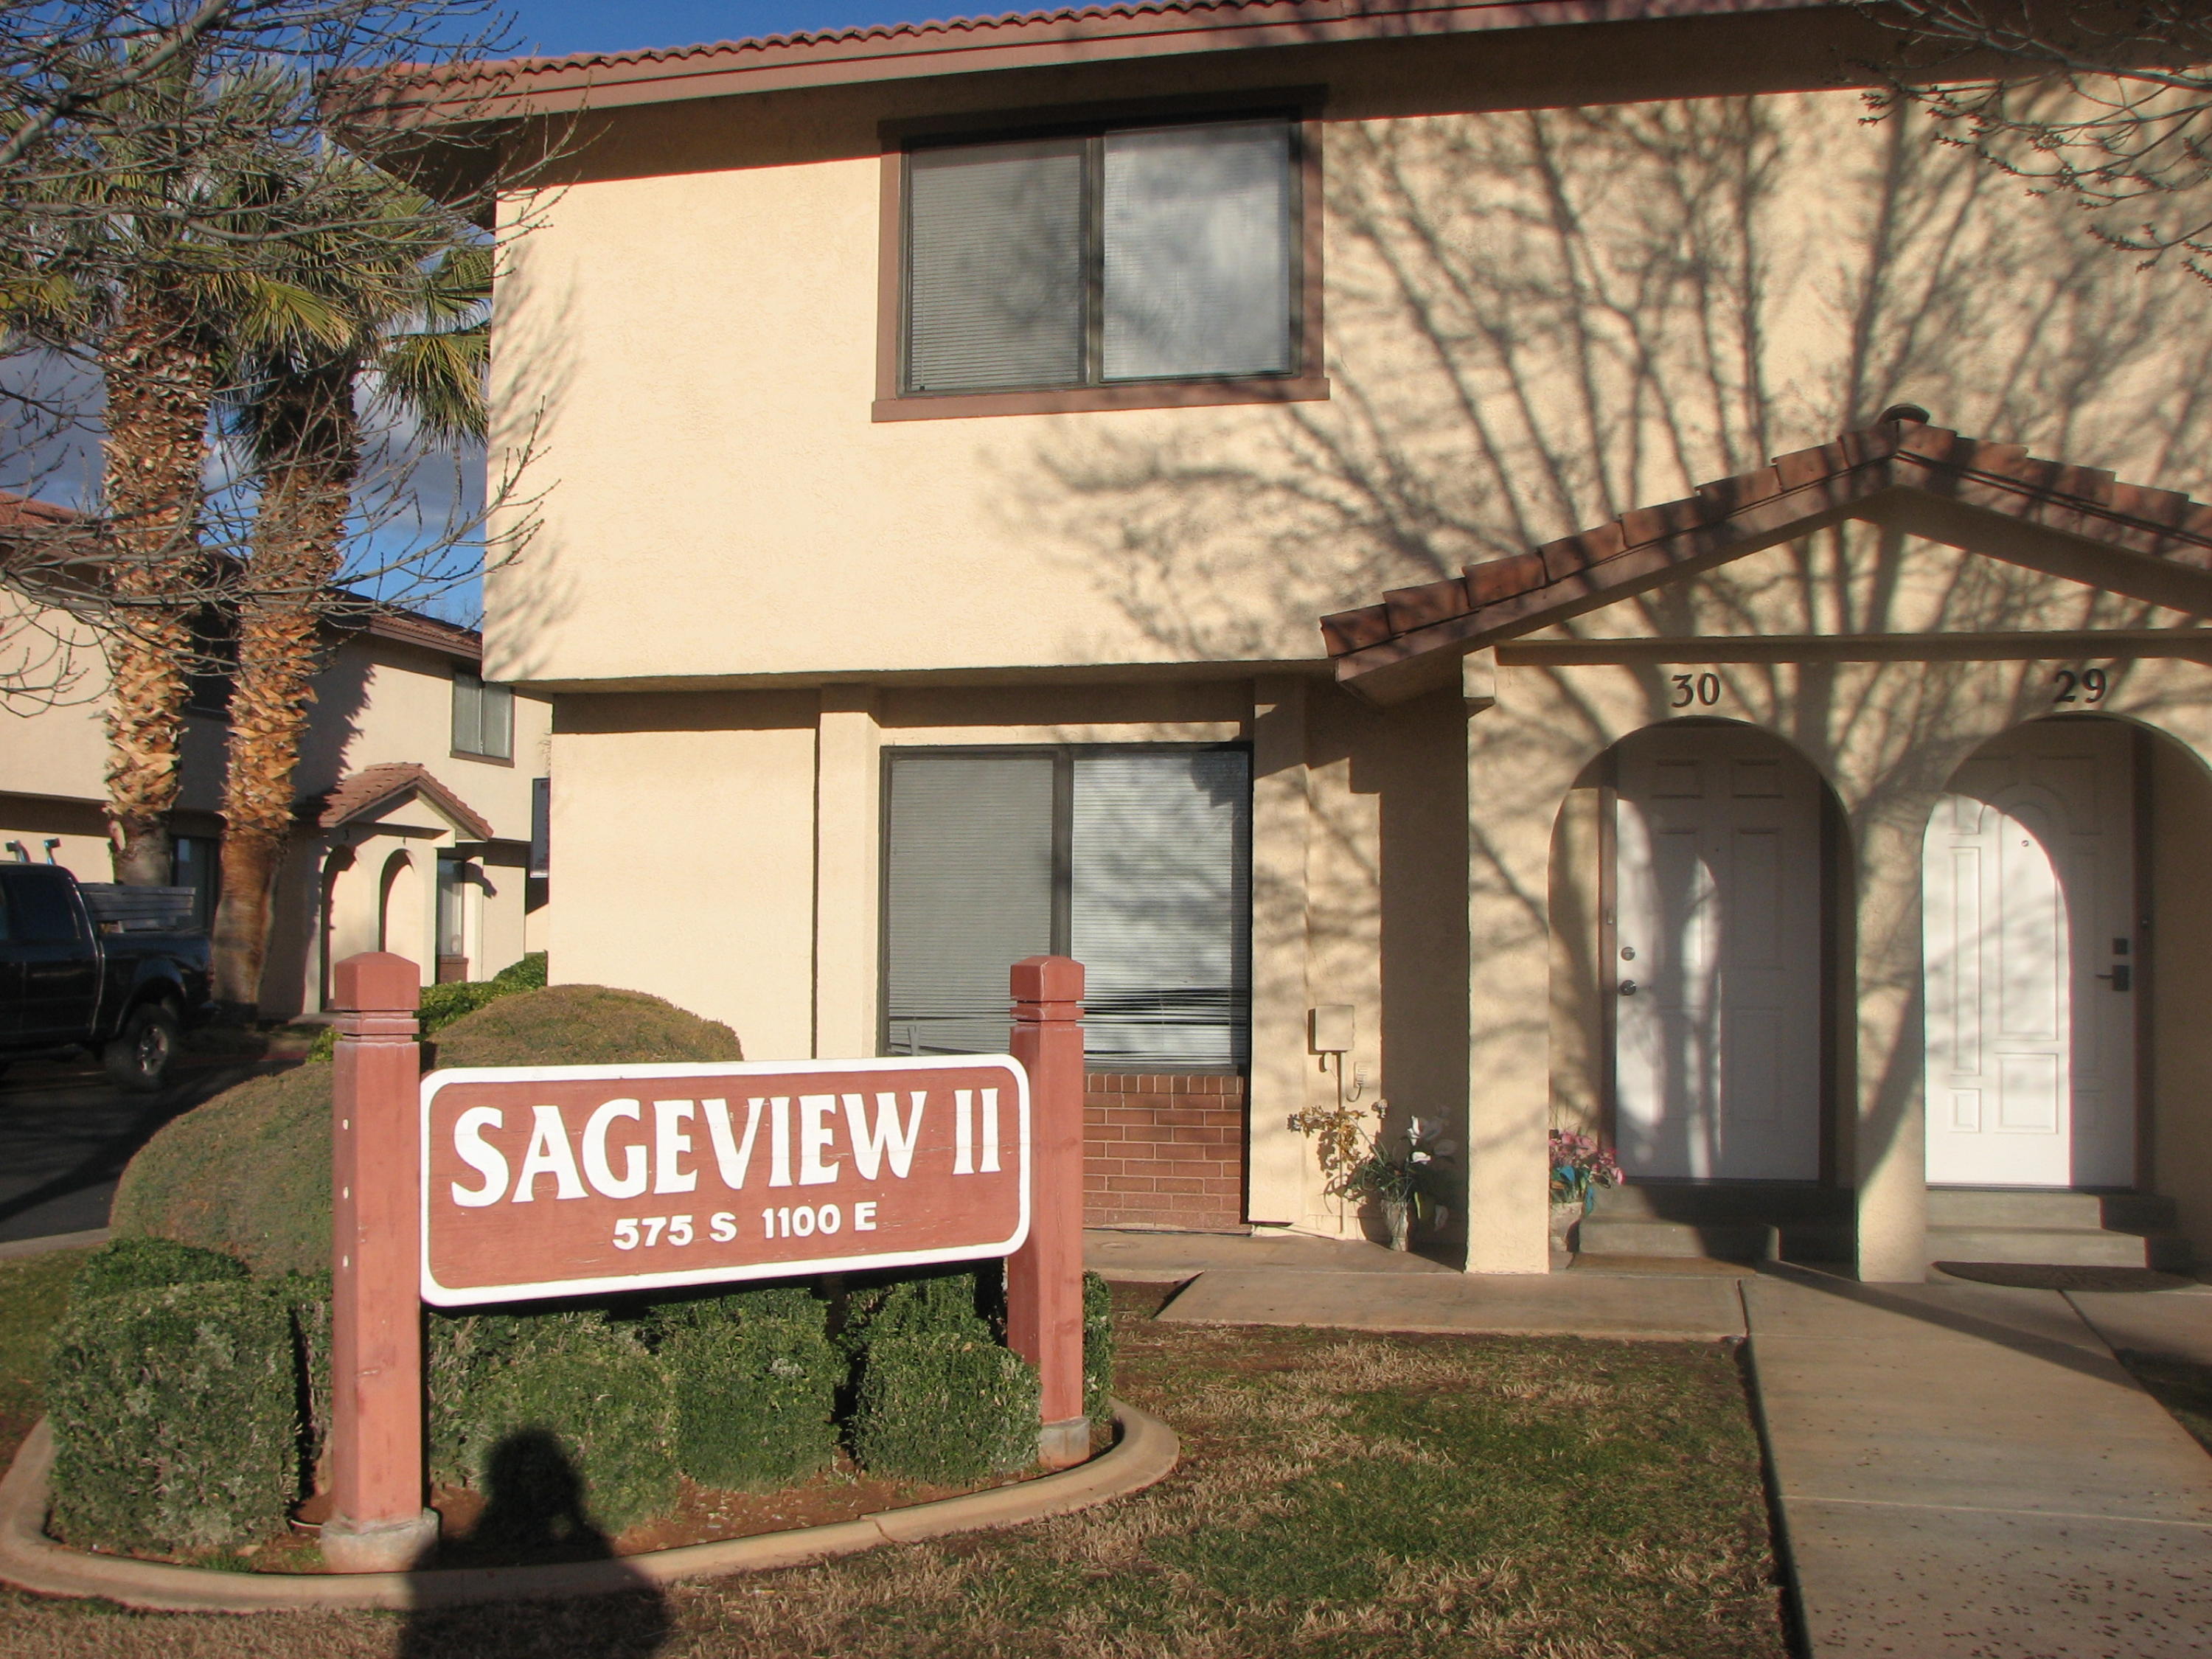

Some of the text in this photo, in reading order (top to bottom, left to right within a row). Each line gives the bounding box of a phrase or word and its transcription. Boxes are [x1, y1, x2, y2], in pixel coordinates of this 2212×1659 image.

[1671, 672, 1719, 708] 30
[2053, 668, 2106, 703] 29
[451, 1088, 1001, 1208] SAGEVIEW II
[613, 1201, 877, 1251] 575 S 1100 E
